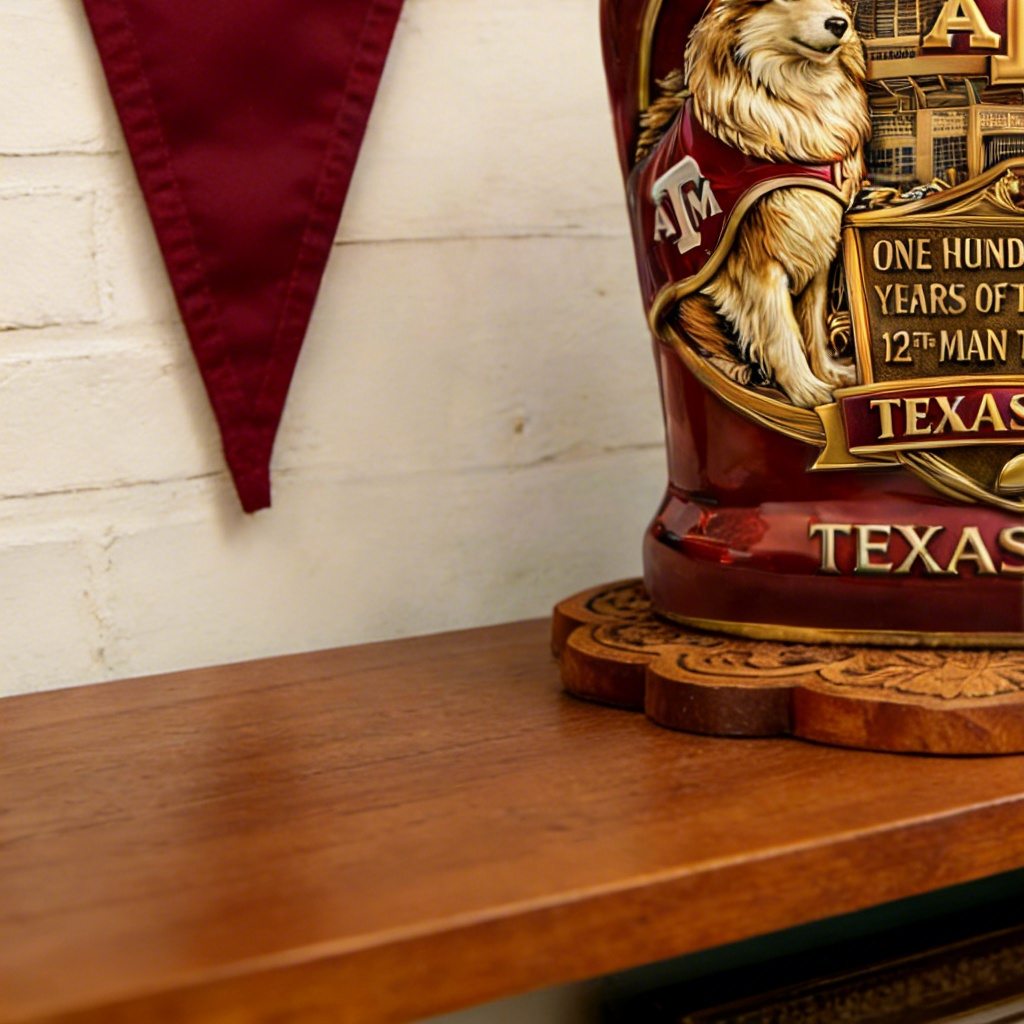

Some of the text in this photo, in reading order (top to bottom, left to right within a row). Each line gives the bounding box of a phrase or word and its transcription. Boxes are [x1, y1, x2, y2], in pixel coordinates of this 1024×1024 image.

[872, 238, 933, 272] ONE
[874, 282, 966, 316] YEARS
[975, 281, 1008, 314] OF
[939, 328, 1009, 363] MAN
